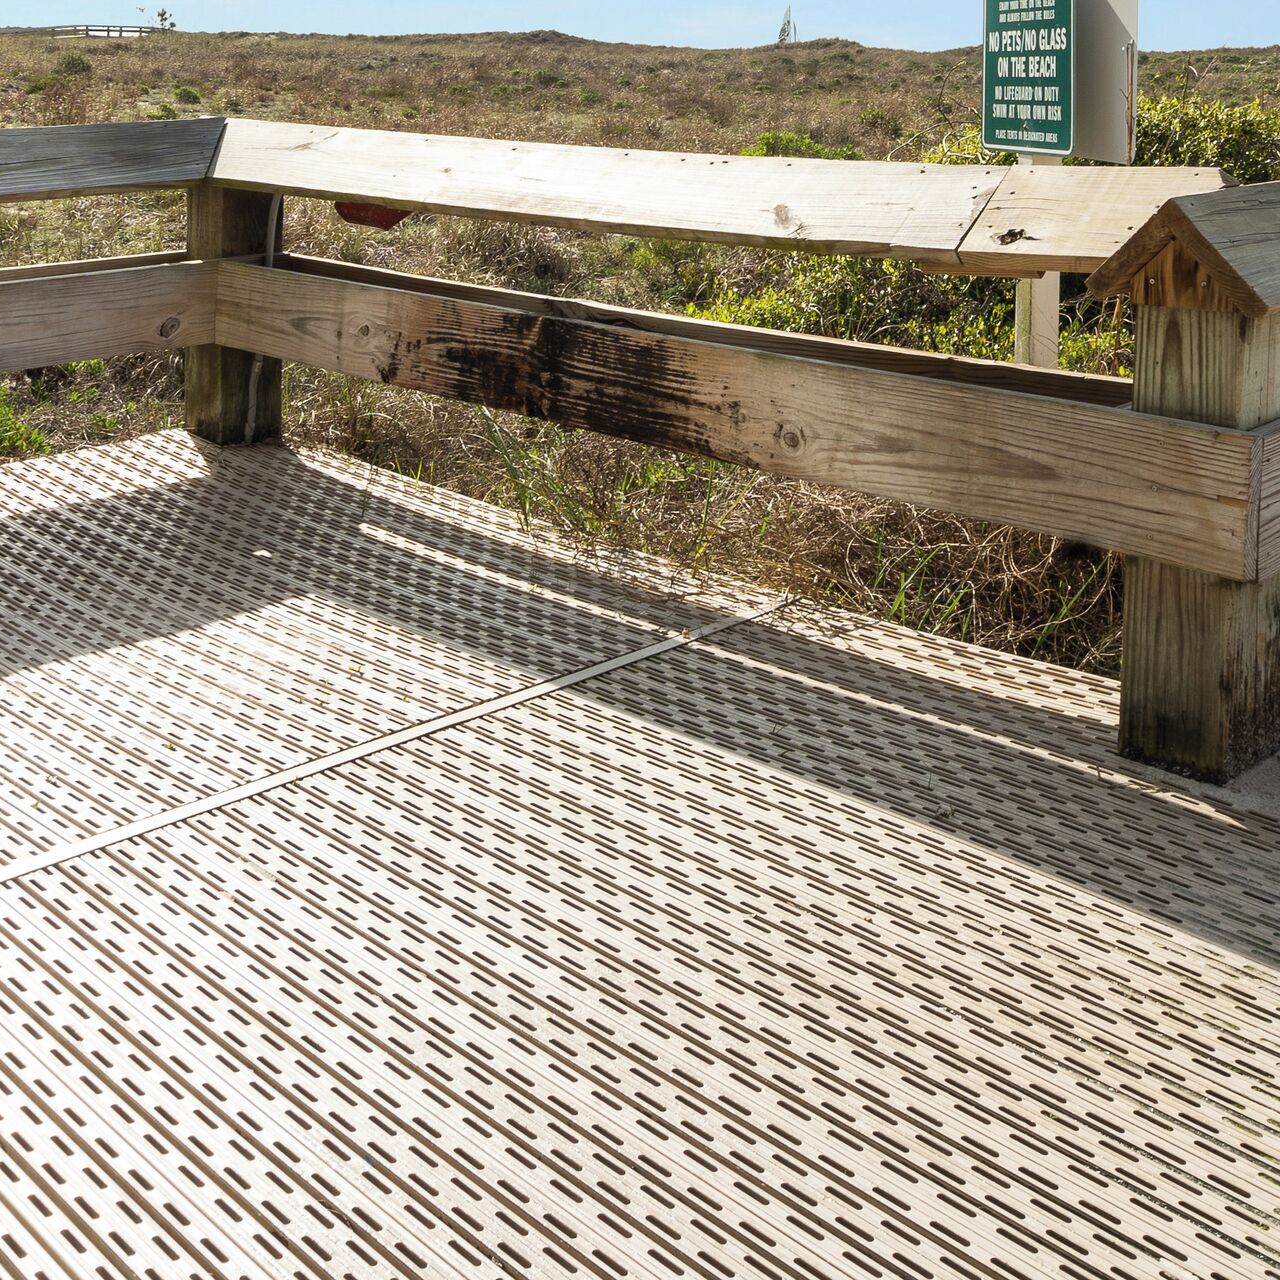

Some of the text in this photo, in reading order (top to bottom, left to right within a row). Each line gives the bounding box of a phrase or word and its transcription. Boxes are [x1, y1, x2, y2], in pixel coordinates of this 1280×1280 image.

[989, 32, 1000, 52] NO
[1039, 28, 1066, 50] GLASS
[998, 56, 1056, 78] ON THE BEACH
[995, 86, 1059, 102] NO LIFEGUARD ON DUTY
[992, 104, 1062, 120] SWIM AT YOUR OWN RISK
[996, 130, 1006, 138] PLACE
[1046, 133, 1058, 142] AREAS
